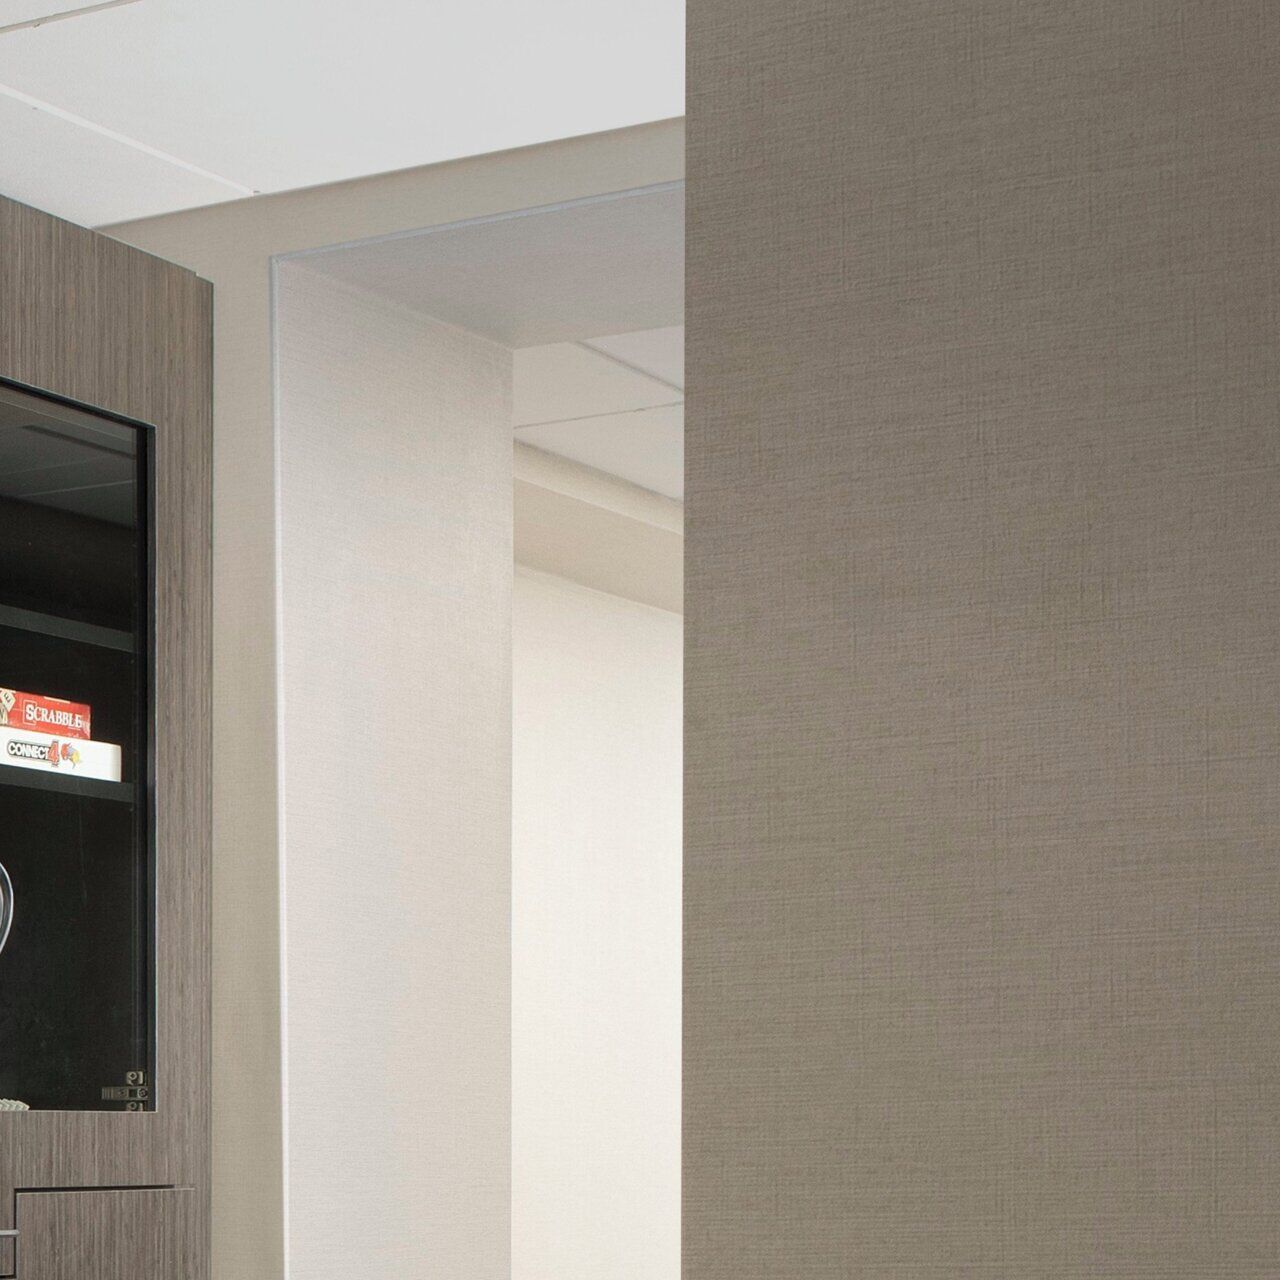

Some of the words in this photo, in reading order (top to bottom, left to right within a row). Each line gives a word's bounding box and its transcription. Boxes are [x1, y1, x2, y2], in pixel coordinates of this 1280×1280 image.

[25, 704, 83, 728] SCRABBLE
[8, 742, 50, 760] CONNECT
[48, 740, 59, 767] 4
